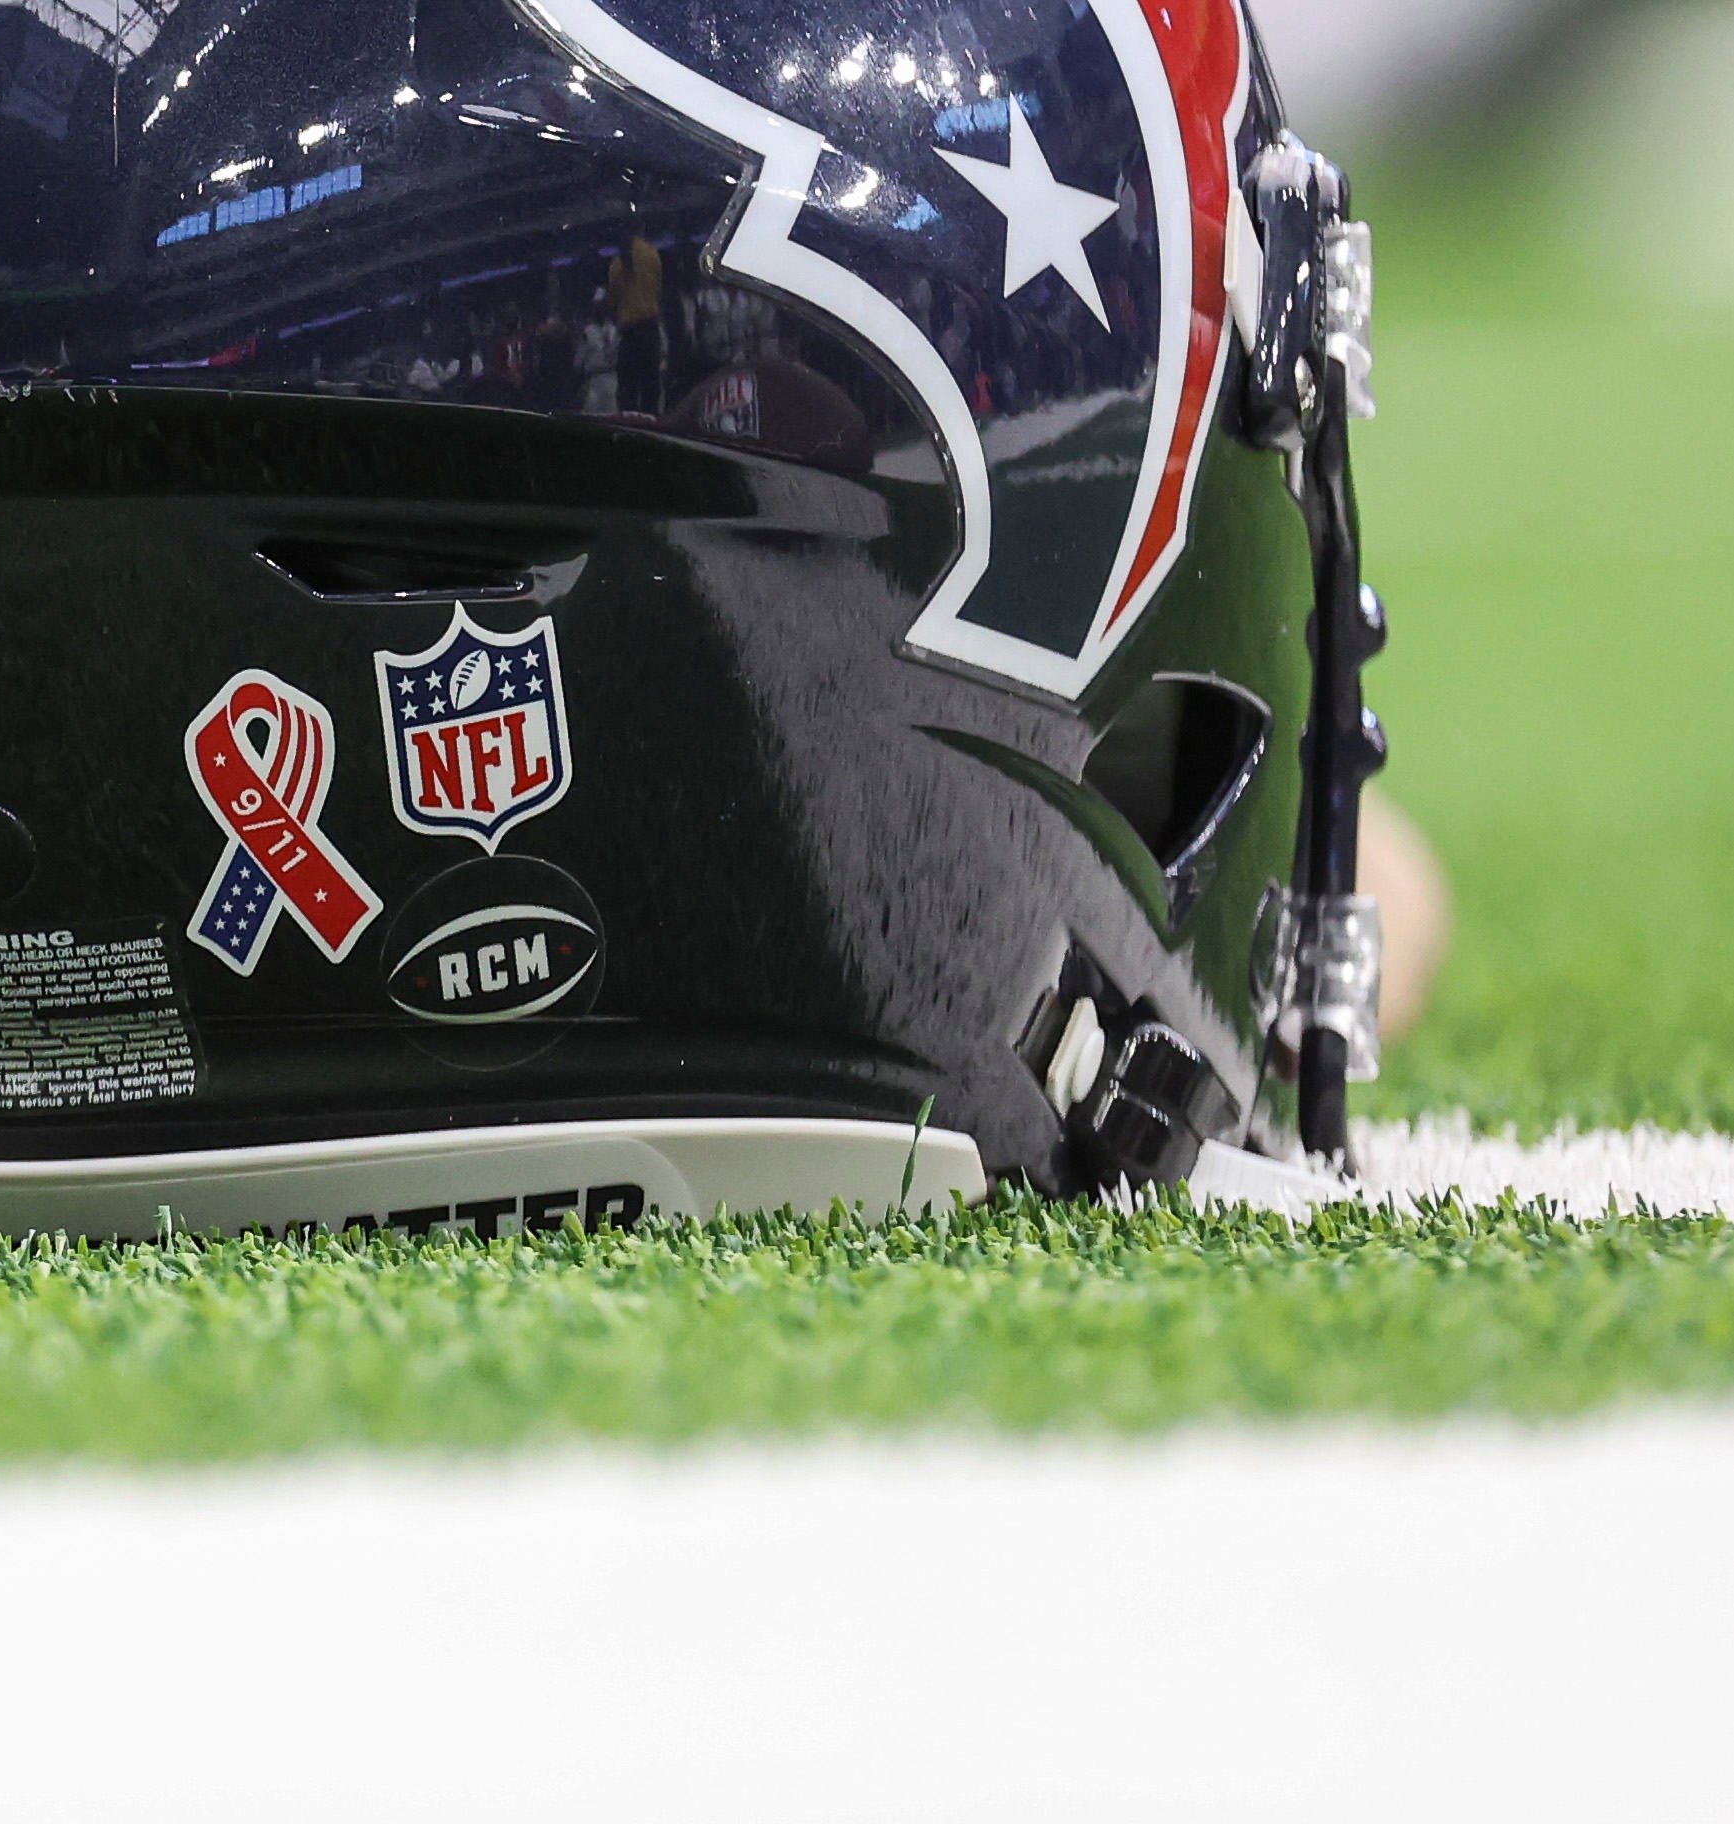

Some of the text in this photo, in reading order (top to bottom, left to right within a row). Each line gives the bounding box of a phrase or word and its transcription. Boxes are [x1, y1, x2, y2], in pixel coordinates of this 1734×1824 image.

[411, 711, 549, 813] NFL
[231, 788, 308, 873] 9/11
[22, 949, 53, 961] HEAD
[56, 947, 73, 958] OR
[76, 943, 108, 956] NECK
[110, 937, 163, 952] INJURIES
[4, 958, 85, 974] PARTICIPATING
[114, 963, 168, 978] opposing
[438, 932, 550, 1001] RCM
[152, 987, 173, 999] you
[65, 1069, 83, 1079] are
[142, 1062, 163, 1074] you
[19, 1096, 64, 1108] serious
[69, 1095, 81, 1106] or
[88, 1090, 115, 1104] fatal
[121, 1088, 153, 1101] brain
[159, 1083, 195, 1098] injury
[48, 1080, 95, 1096] Ignoring
[98, 1078, 120, 1090] this
[123, 1074, 169, 1088] warning
[241, 1184, 645, 1251] TTER
